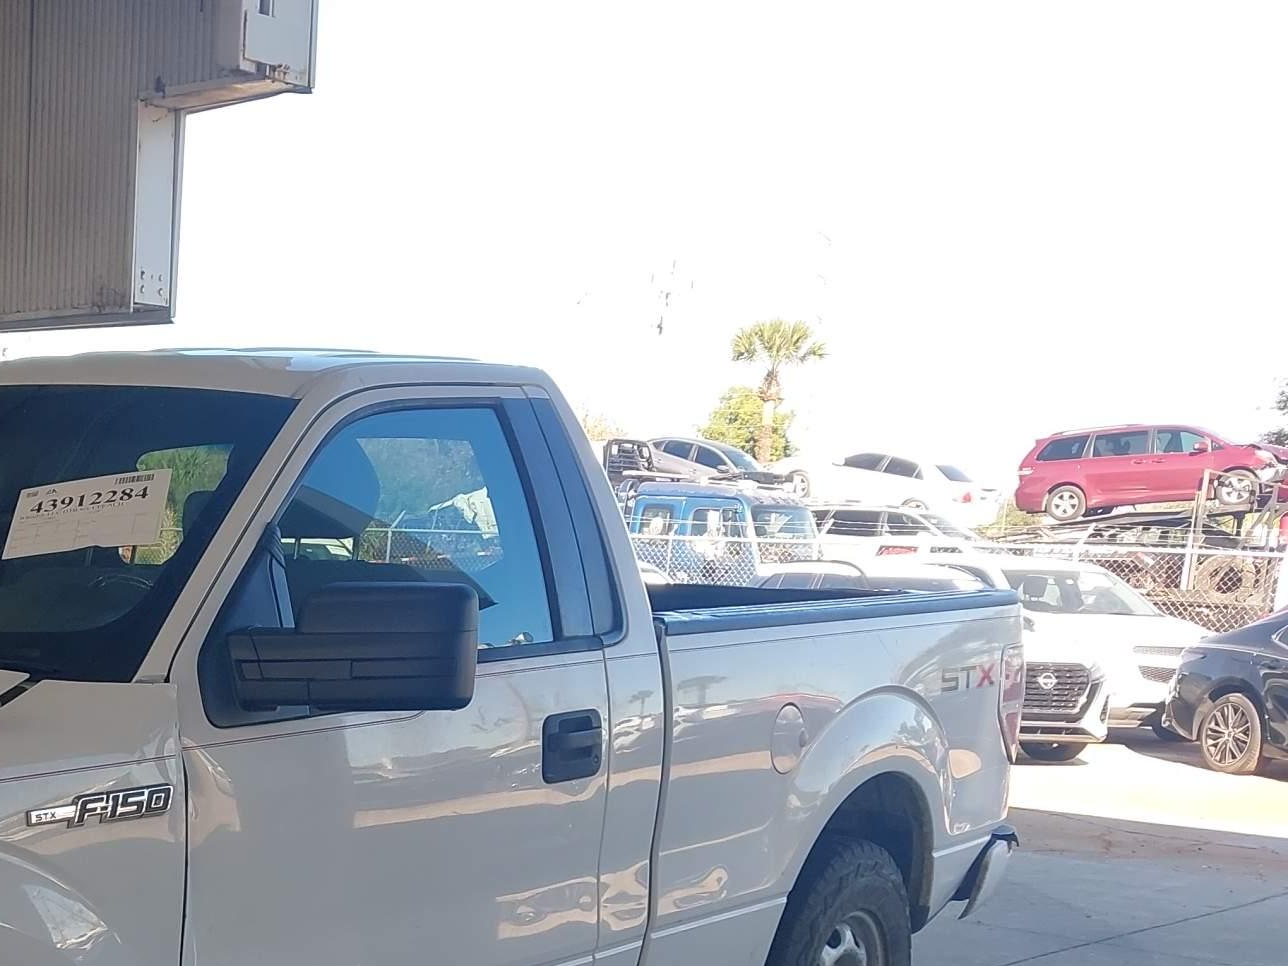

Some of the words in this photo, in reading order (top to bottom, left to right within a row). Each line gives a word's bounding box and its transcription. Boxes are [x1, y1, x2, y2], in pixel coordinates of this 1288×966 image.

[30, 486, 149, 514] 43912284
[941, 664, 994, 692] STX
[35, 811, 57, 822] STX
[74, 784, 173, 826] F-150
